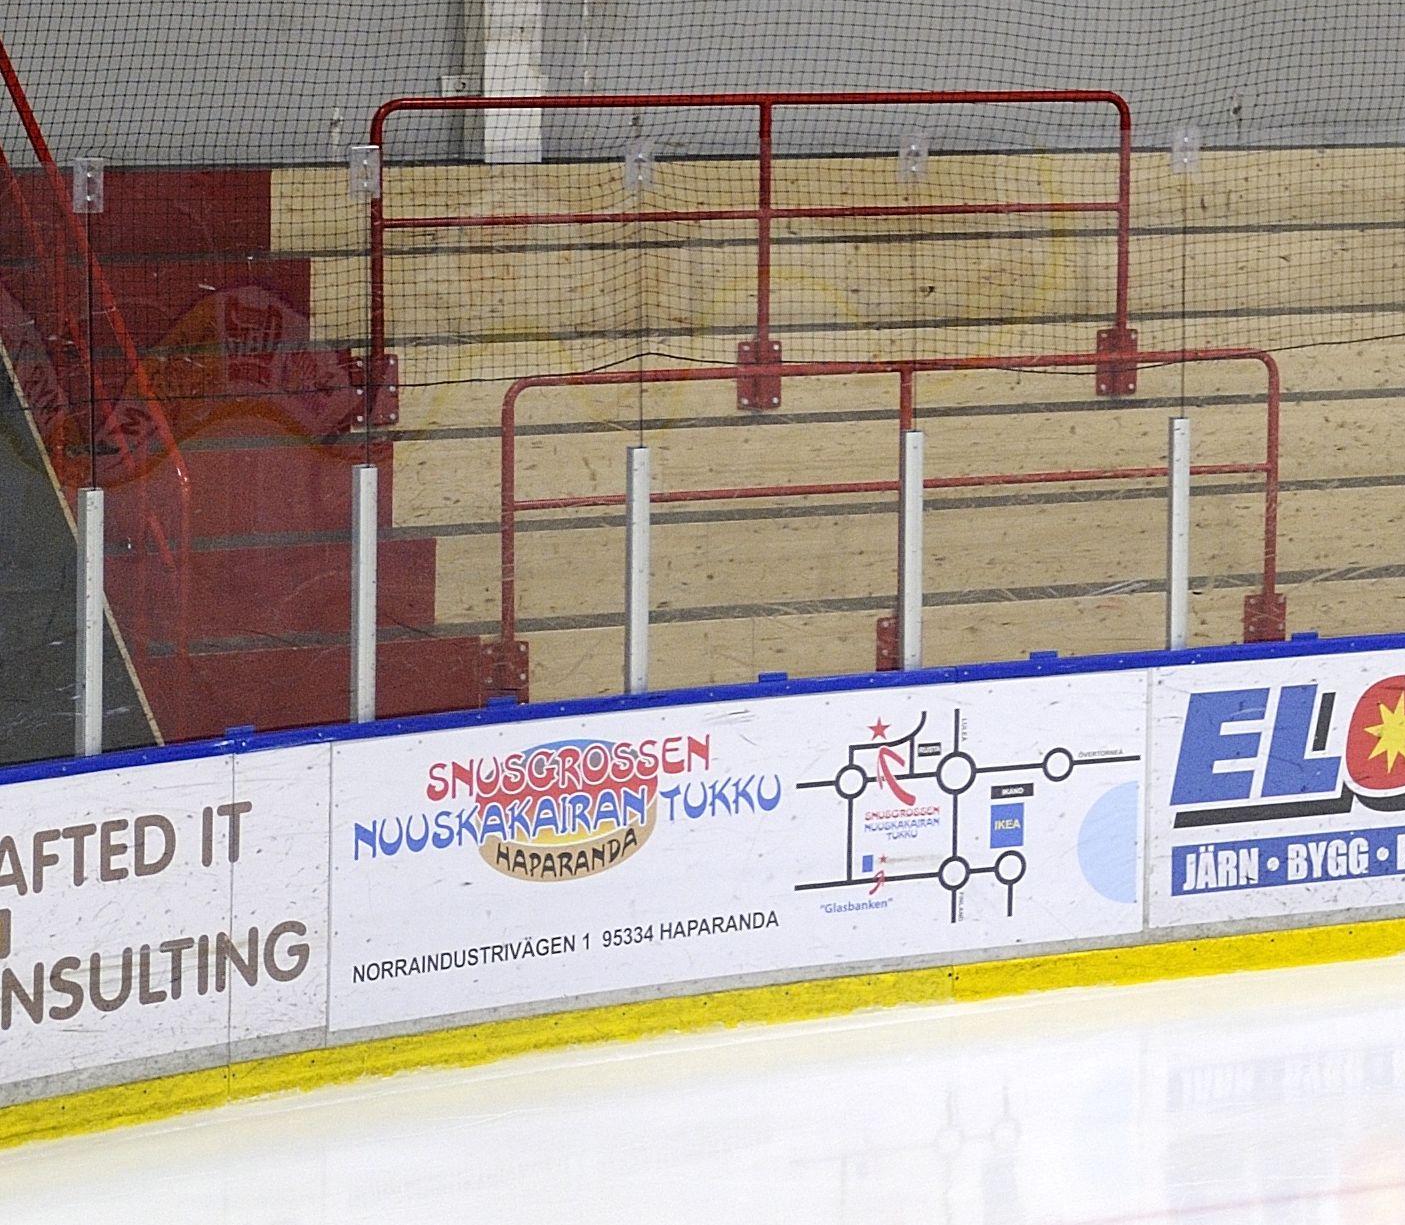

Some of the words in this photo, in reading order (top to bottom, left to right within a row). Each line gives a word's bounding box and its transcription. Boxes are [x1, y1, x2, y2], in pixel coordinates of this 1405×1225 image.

[426, 734, 710, 802] SNUSGROSSEN
[0, 814, 177, 896] AFTED
[201, 800, 253, 867] IT
[354, 786, 647, 860] NUUSKAKAIRAN
[659, 774, 782, 821] TUKKU
[496, 827, 638, 878] HAPARANDA
[994, 819, 1021, 830] IKEA
[1183, 845, 1260, 891] JÄRN
[1287, 838, 1369, 880] BYGG
[1, 920, 312, 1031] NSULTING
[352, 935, 576, 984] NORRAINDUSTRIVÄGEN
[582, 933, 591, 951] 1
[602, 924, 654, 949] 95334
[659, 910, 780, 942] HAPARANDA
